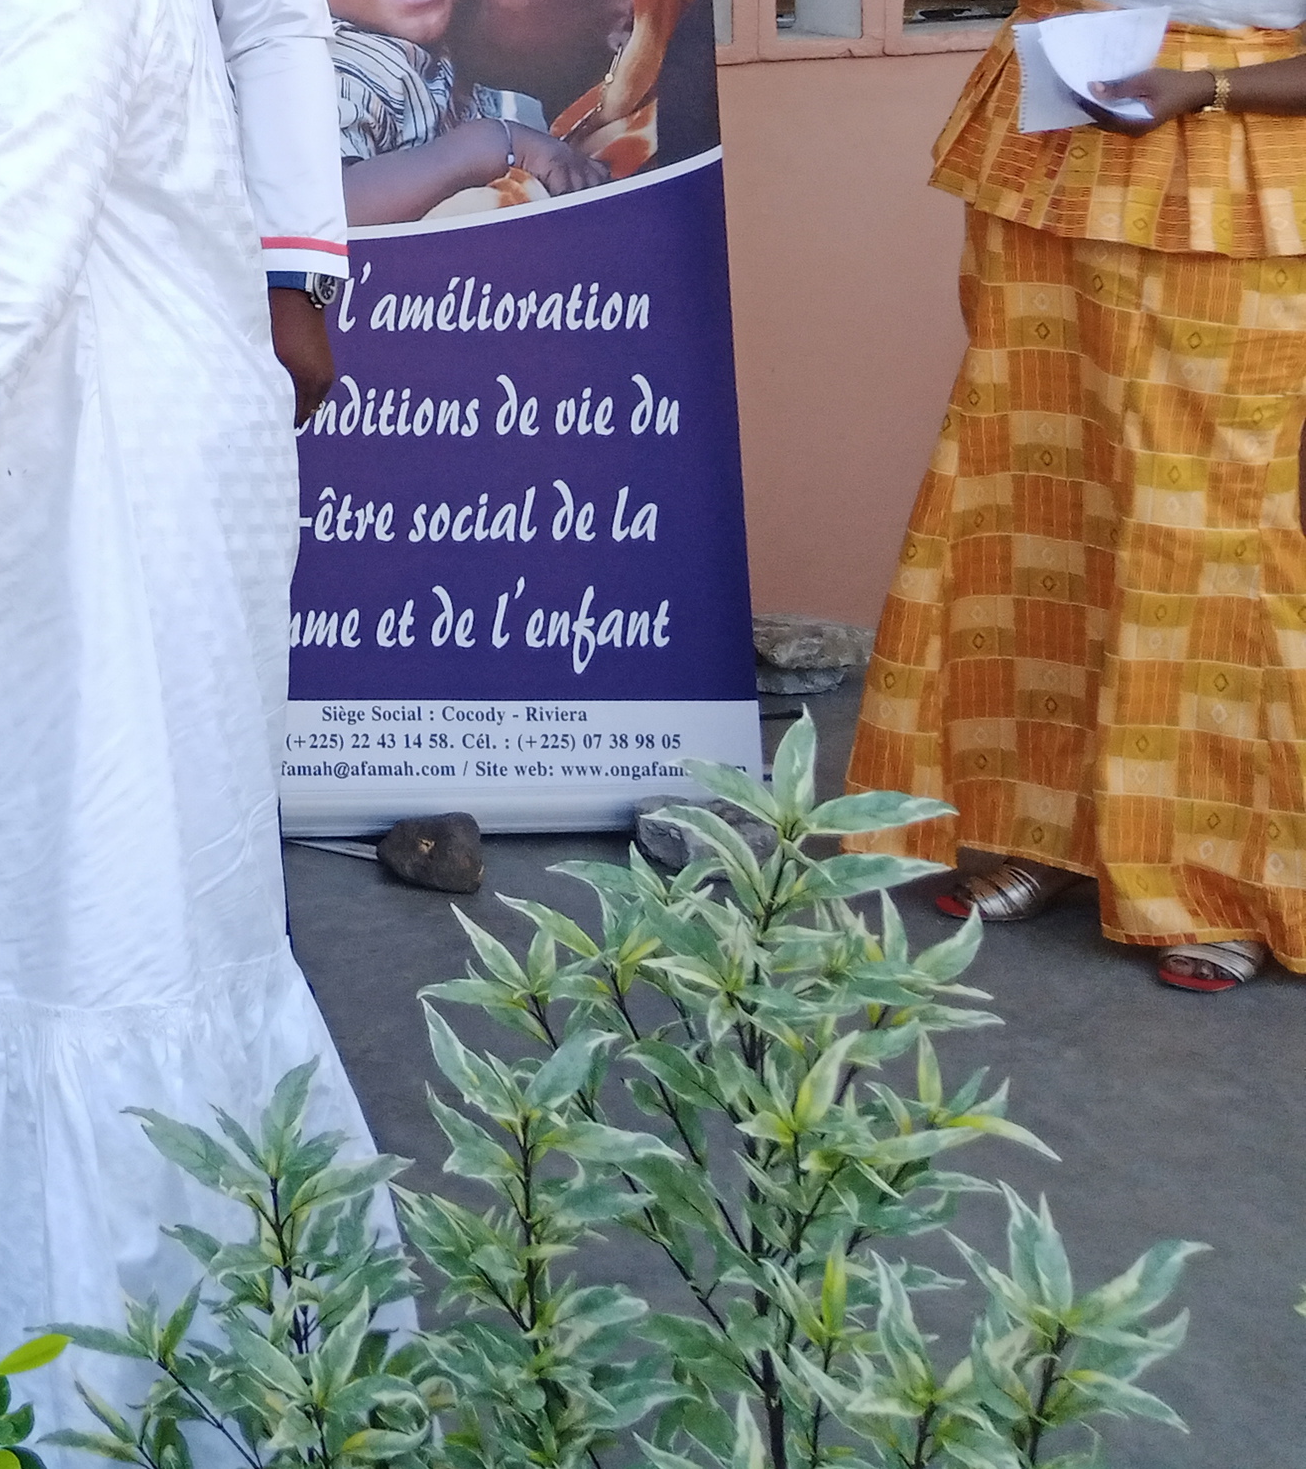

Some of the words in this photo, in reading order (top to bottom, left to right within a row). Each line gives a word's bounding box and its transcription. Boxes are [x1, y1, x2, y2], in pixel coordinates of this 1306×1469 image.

[338, 261, 651, 333] l'amélioration
[495, 374, 540, 436] de
[554, 388, 616, 436] vie
[630, 373, 681, 435] du
[408, 485, 537, 543] social
[551, 479, 596, 543] de
[612, 485, 658, 543] la
[375, 598, 415, 648] et
[431, 585, 477, 648] de
[492, 576, 670, 674] l'enfant
[285, 732, 345, 752] (+225)
[351, 733, 371, 750] 22
[376, 733, 397, 750] 43
[403, 733, 423, 750] 14
[428, 733, 455, 750] 58.
[461, 732, 497, 750] Cél.
[516, 732, 576, 752] (+225)
[582, 733, 602, 750] 07
[608, 733, 629, 750] 38
[634, 733, 655, 750] 98
[661, 733, 682, 750] 05
[321, 705, 366, 725] Siège
[370, 705, 422, 722] Social
[441, 705, 506, 725] Cocody
[525, 705, 588, 722] Riviera
[475, 760, 509, 778] Site
[513, 760, 554, 778] web:
